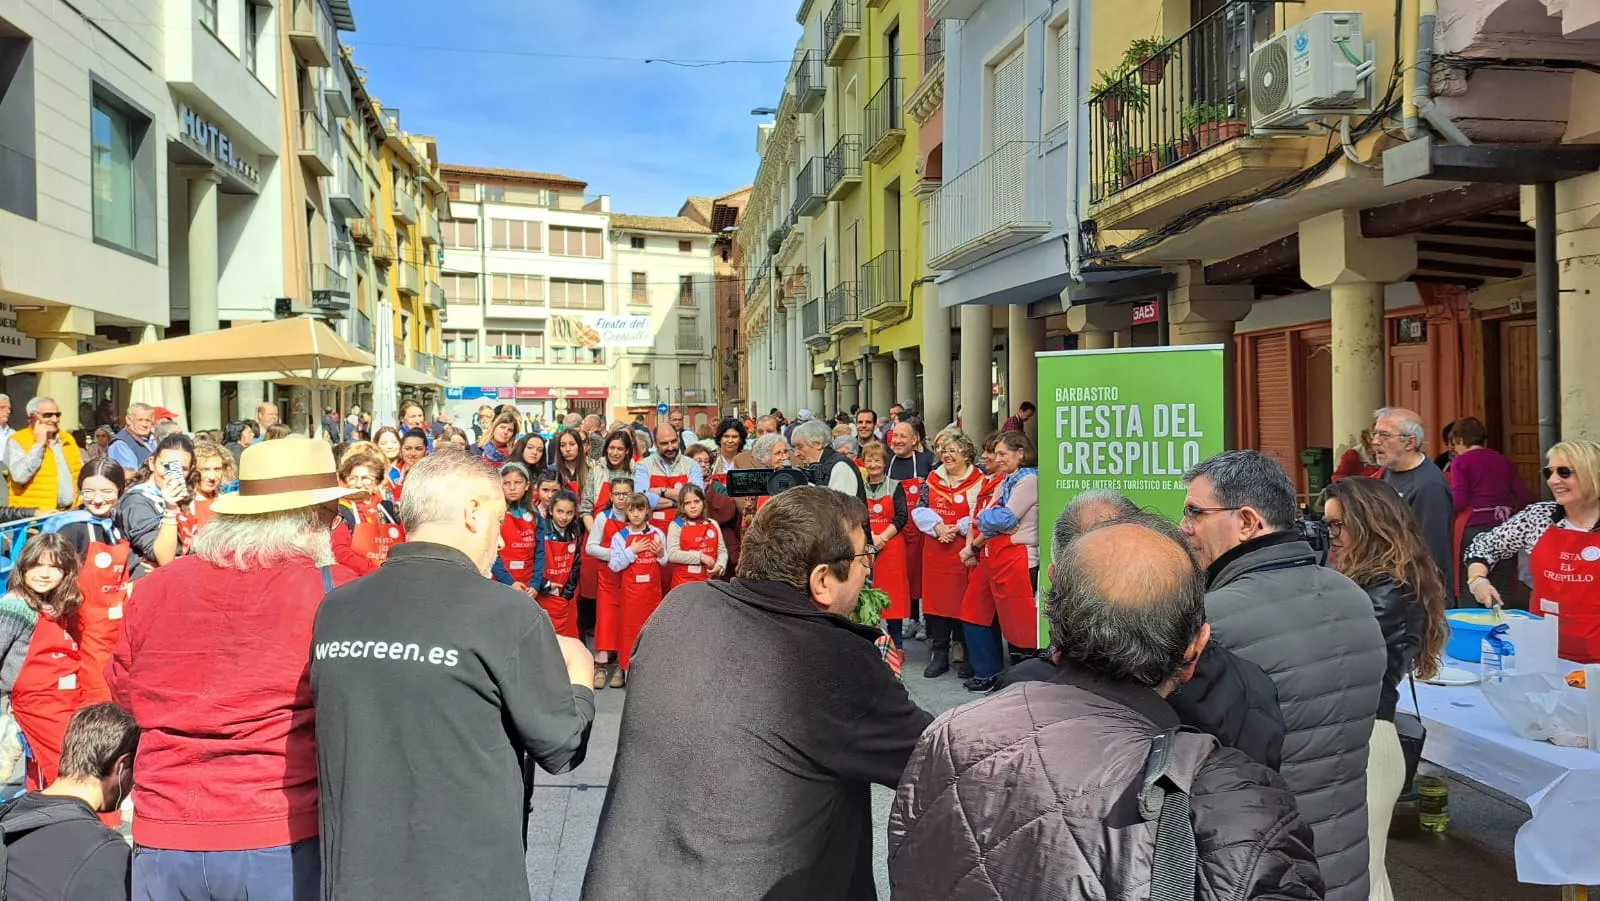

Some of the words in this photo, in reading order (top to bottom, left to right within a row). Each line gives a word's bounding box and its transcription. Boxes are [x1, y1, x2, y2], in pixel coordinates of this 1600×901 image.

[183, 105, 237, 169] HOTEL
[1133, 304, 1155, 320] GAES
[596, 318, 627, 329] Fiesta
[629, 318, 646, 329] del
[1055, 386, 1118, 402] BARBASTRO
[1055, 404, 1144, 439] FIESTA
[1153, 403, 1203, 438] DEL
[1058, 440, 1199, 476] CRESPILLO
[1056, 480, 1079, 489] FIESTA
[1081, 480, 1090, 489] DE
[1092, 479, 1121, 490] INTERÉS
[1123, 479, 1160, 490] TURÍSTICO
[1162, 480, 1172, 490] DE
[315, 641, 458, 667] wescreen.es
